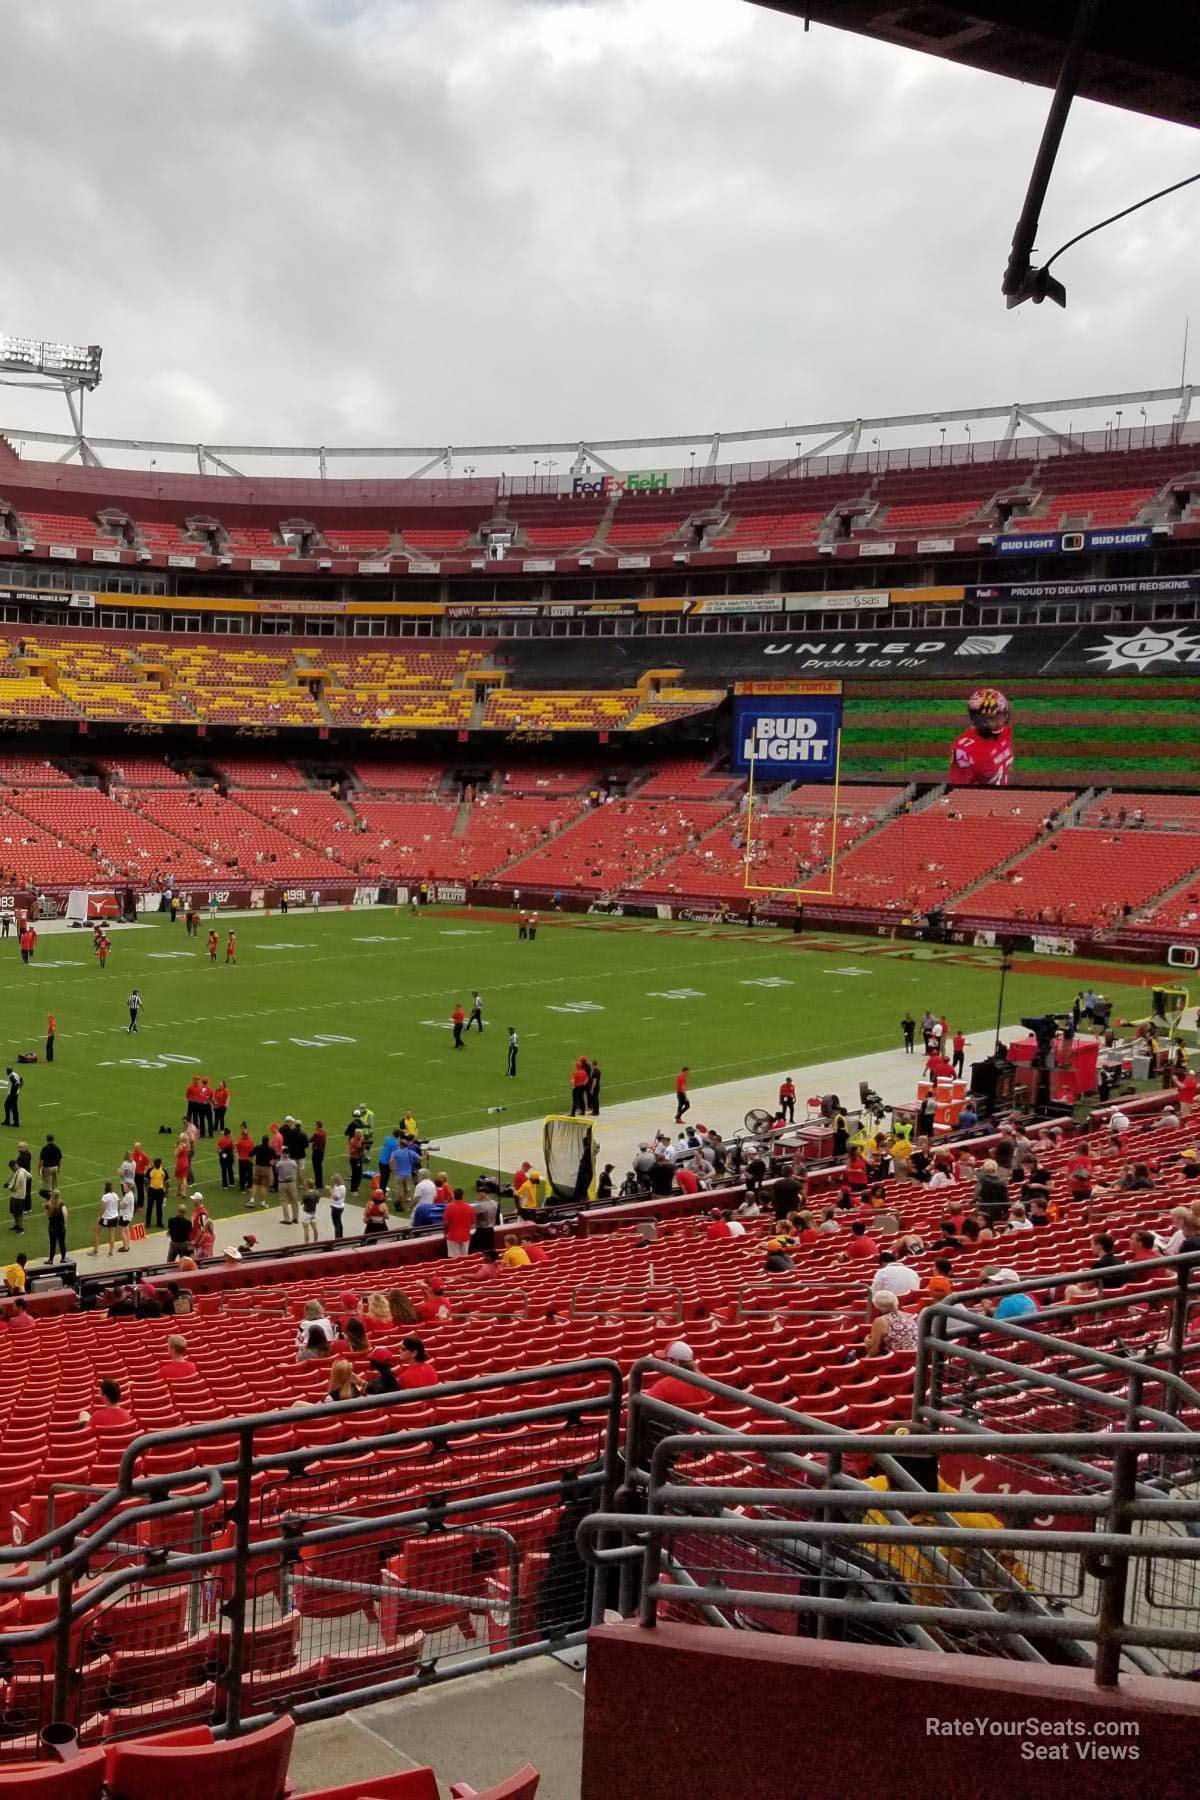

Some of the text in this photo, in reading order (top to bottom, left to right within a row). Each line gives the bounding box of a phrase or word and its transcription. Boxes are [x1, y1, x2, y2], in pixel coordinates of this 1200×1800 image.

[1001, 538, 1055, 550] BUD LIGHT
[1091, 533, 1147, 546] BUD LIGHT
[1011, 588, 1043, 597] PROUD
[1043, 587, 1056, 595] TO
[1058, 585, 1096, 595] DELIVER
[1099, 584, 1117, 593] FOR
[1118, 583, 1137, 591] THE
[763, 642, 947, 654] UNITED
[801, 657, 928, 669] Proud to fly
[756, 718, 817, 739] BUD
[744, 739, 829, 760] LIGHT
[119, 1053, 202, 1070] 30
